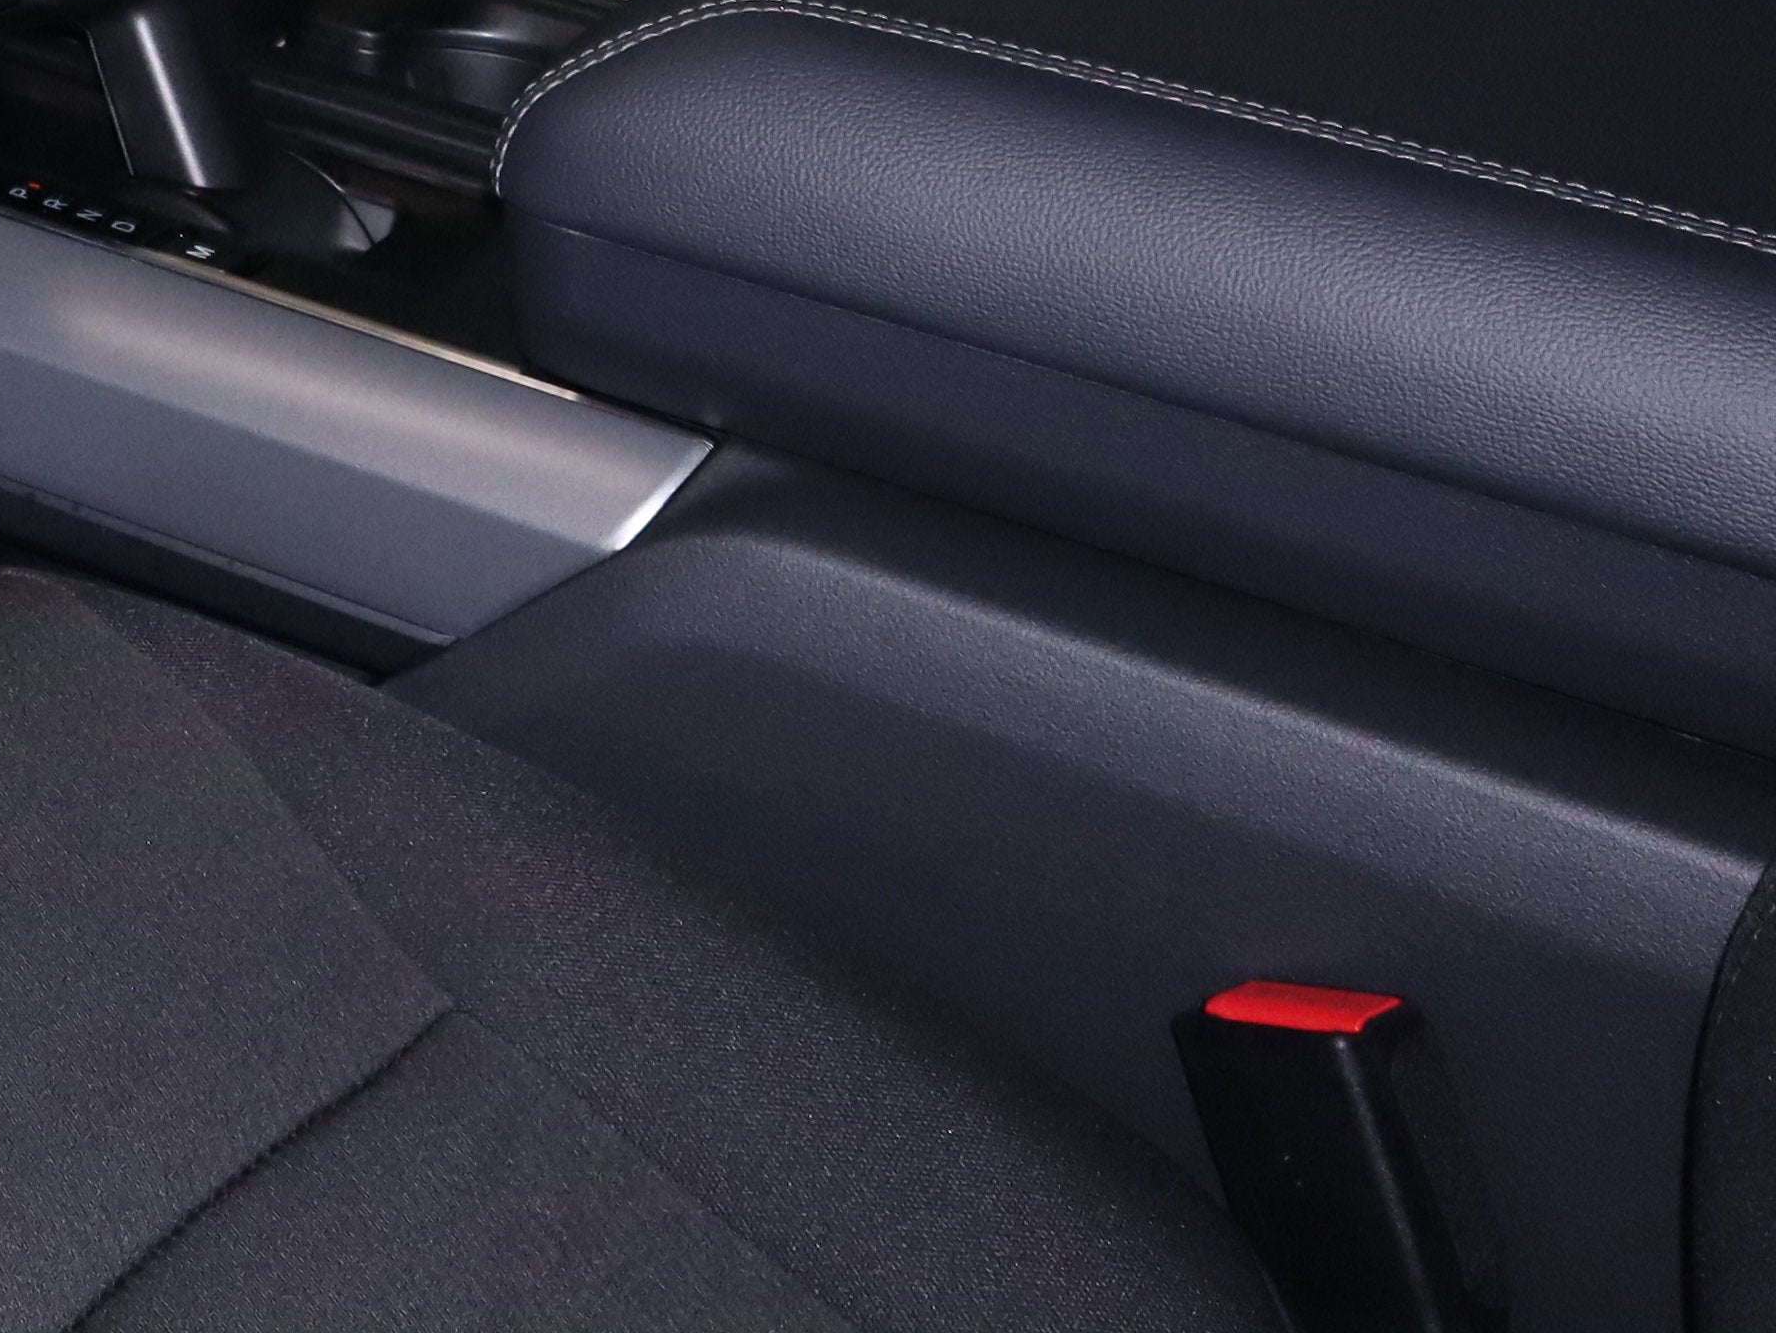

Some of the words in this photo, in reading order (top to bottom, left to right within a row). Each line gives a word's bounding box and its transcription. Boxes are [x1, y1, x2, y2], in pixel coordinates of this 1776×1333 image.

[9, 187, 28, 200] P
[43, 198, 68, 210] R
[76, 209, 103, 222] N
[111, 220, 136, 233] D
[185, 244, 215, 260] M
